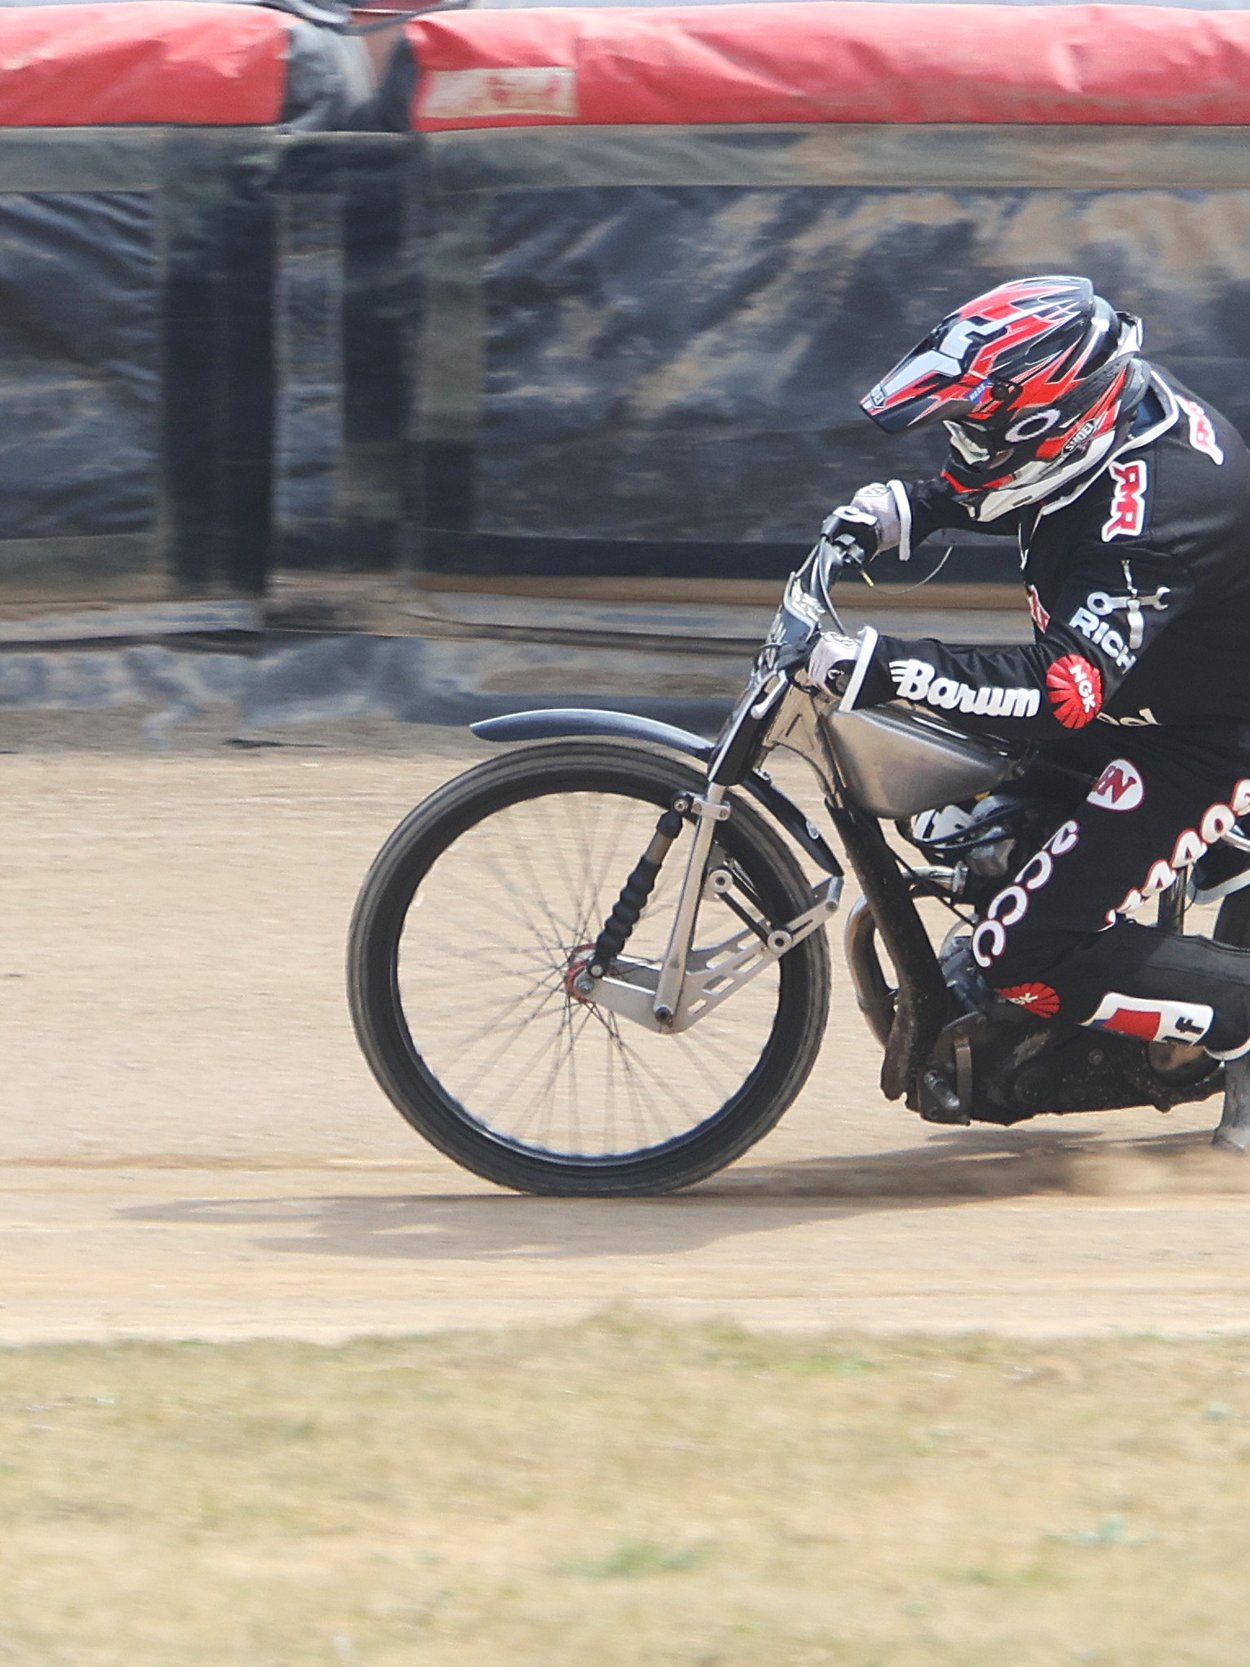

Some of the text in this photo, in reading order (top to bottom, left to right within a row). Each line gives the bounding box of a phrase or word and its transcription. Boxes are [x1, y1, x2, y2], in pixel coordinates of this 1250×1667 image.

[1069, 606, 1136, 674] RICH
[889, 658, 1041, 718] Barum
[1068, 664, 1096, 713] NGK
